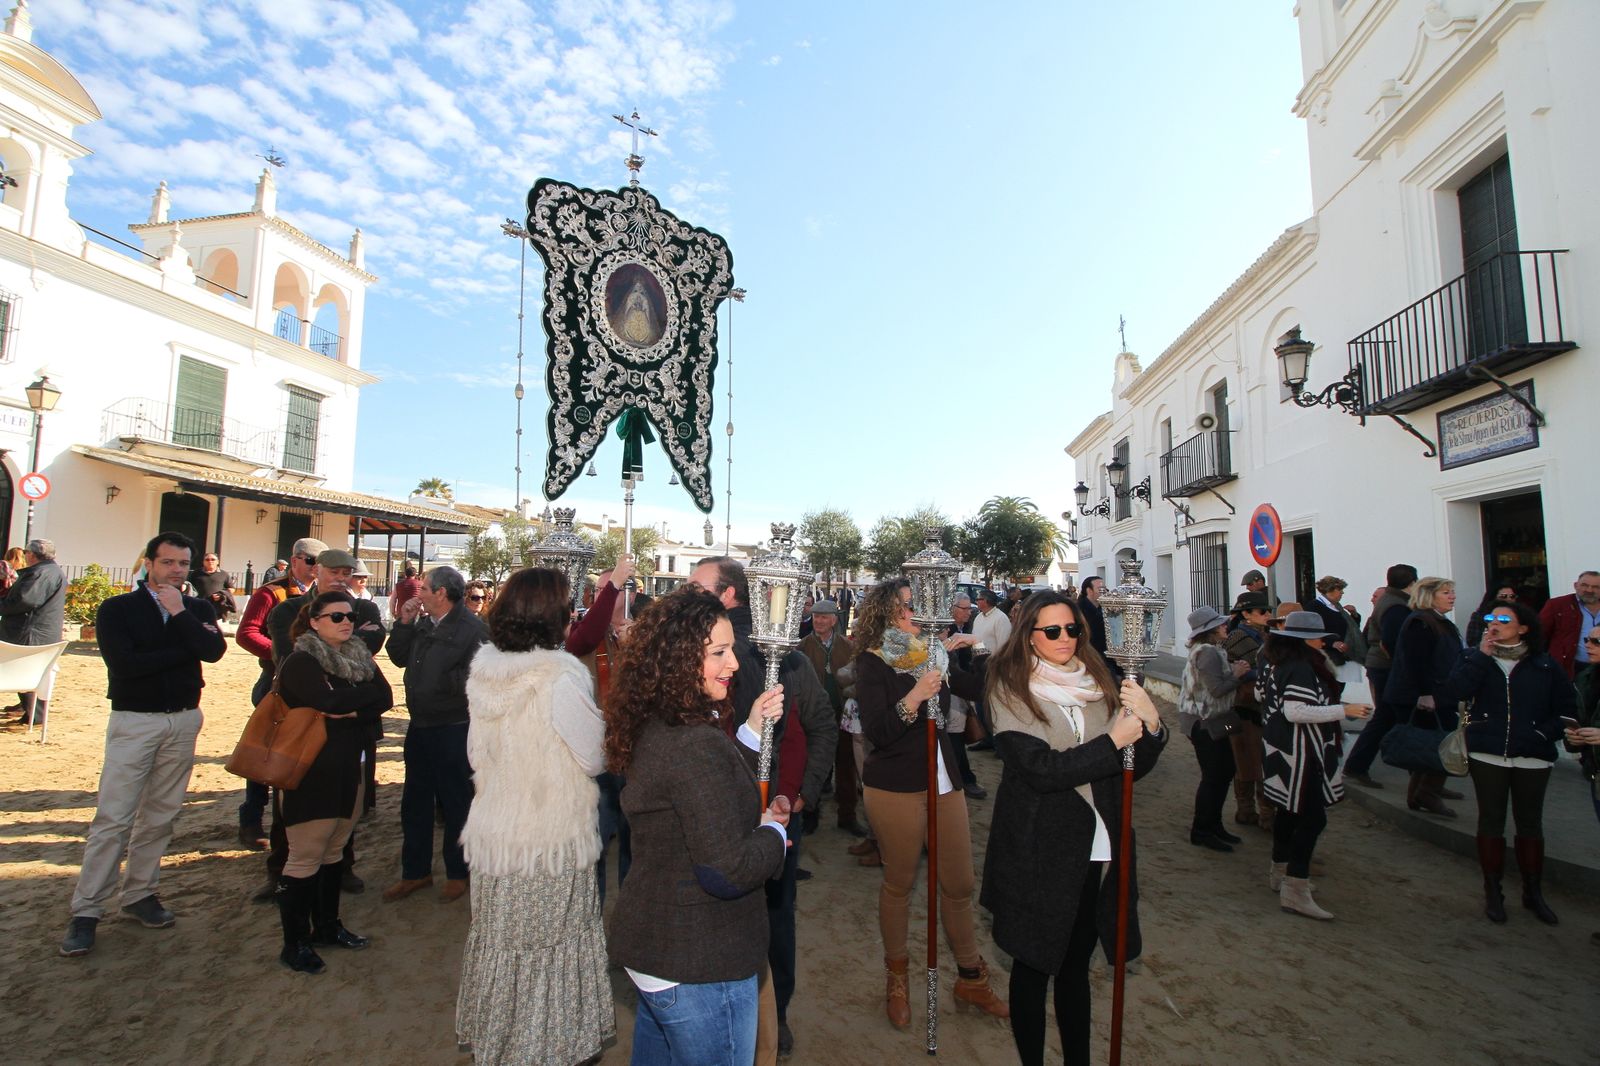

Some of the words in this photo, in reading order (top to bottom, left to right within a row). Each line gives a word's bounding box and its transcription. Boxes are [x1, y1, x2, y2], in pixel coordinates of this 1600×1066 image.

[0, 413, 28, 427] UER
[1457, 403, 1510, 430] RECUERDOS
[1489, 421, 1499, 437] del
